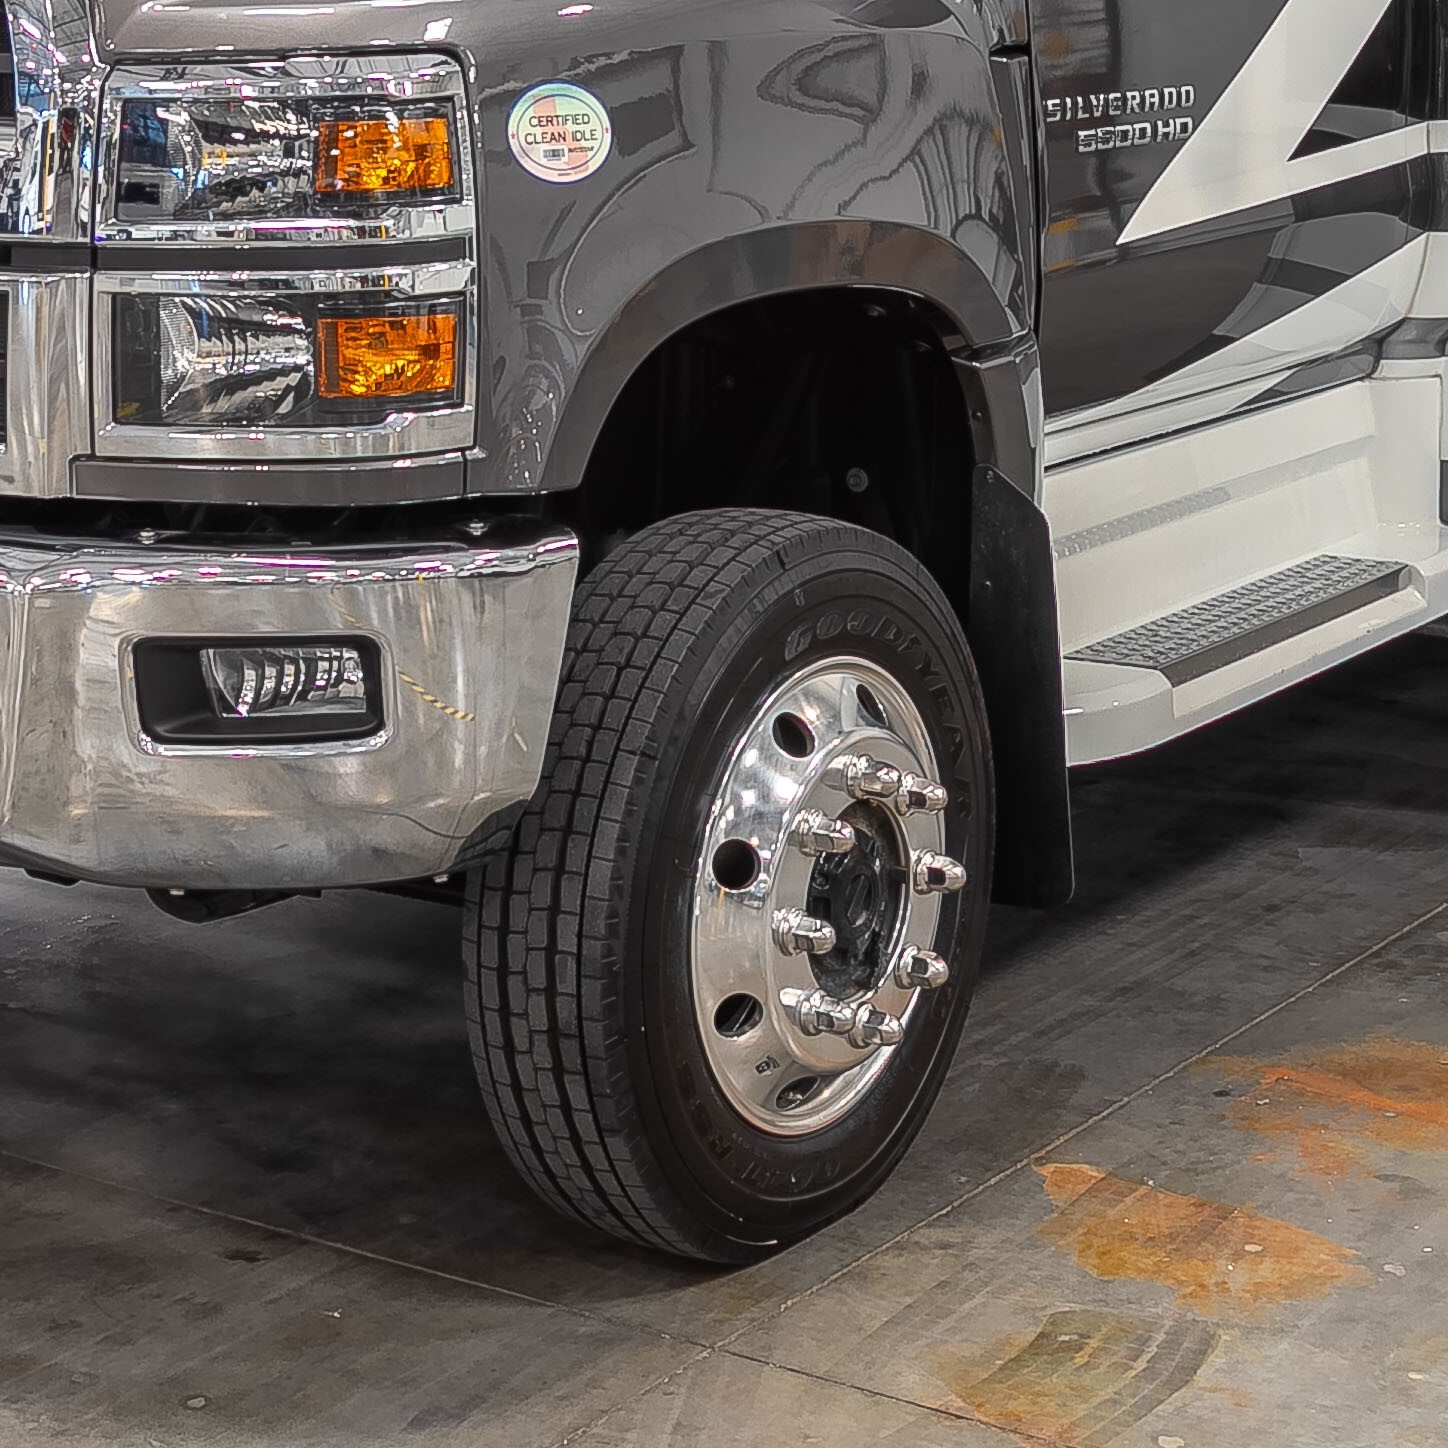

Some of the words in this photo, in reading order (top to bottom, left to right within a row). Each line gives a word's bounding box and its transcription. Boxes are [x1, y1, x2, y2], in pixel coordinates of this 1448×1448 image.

[1046, 85, 1195, 123] SILVERADO
[528, 113, 591, 128] CERTIFIED
[524, 131, 567, 146] CLEAN
[571, 128, 599, 143] IDLE
[1077, 121, 1152, 153] 5500
[1156, 116, 1193, 143] HD
